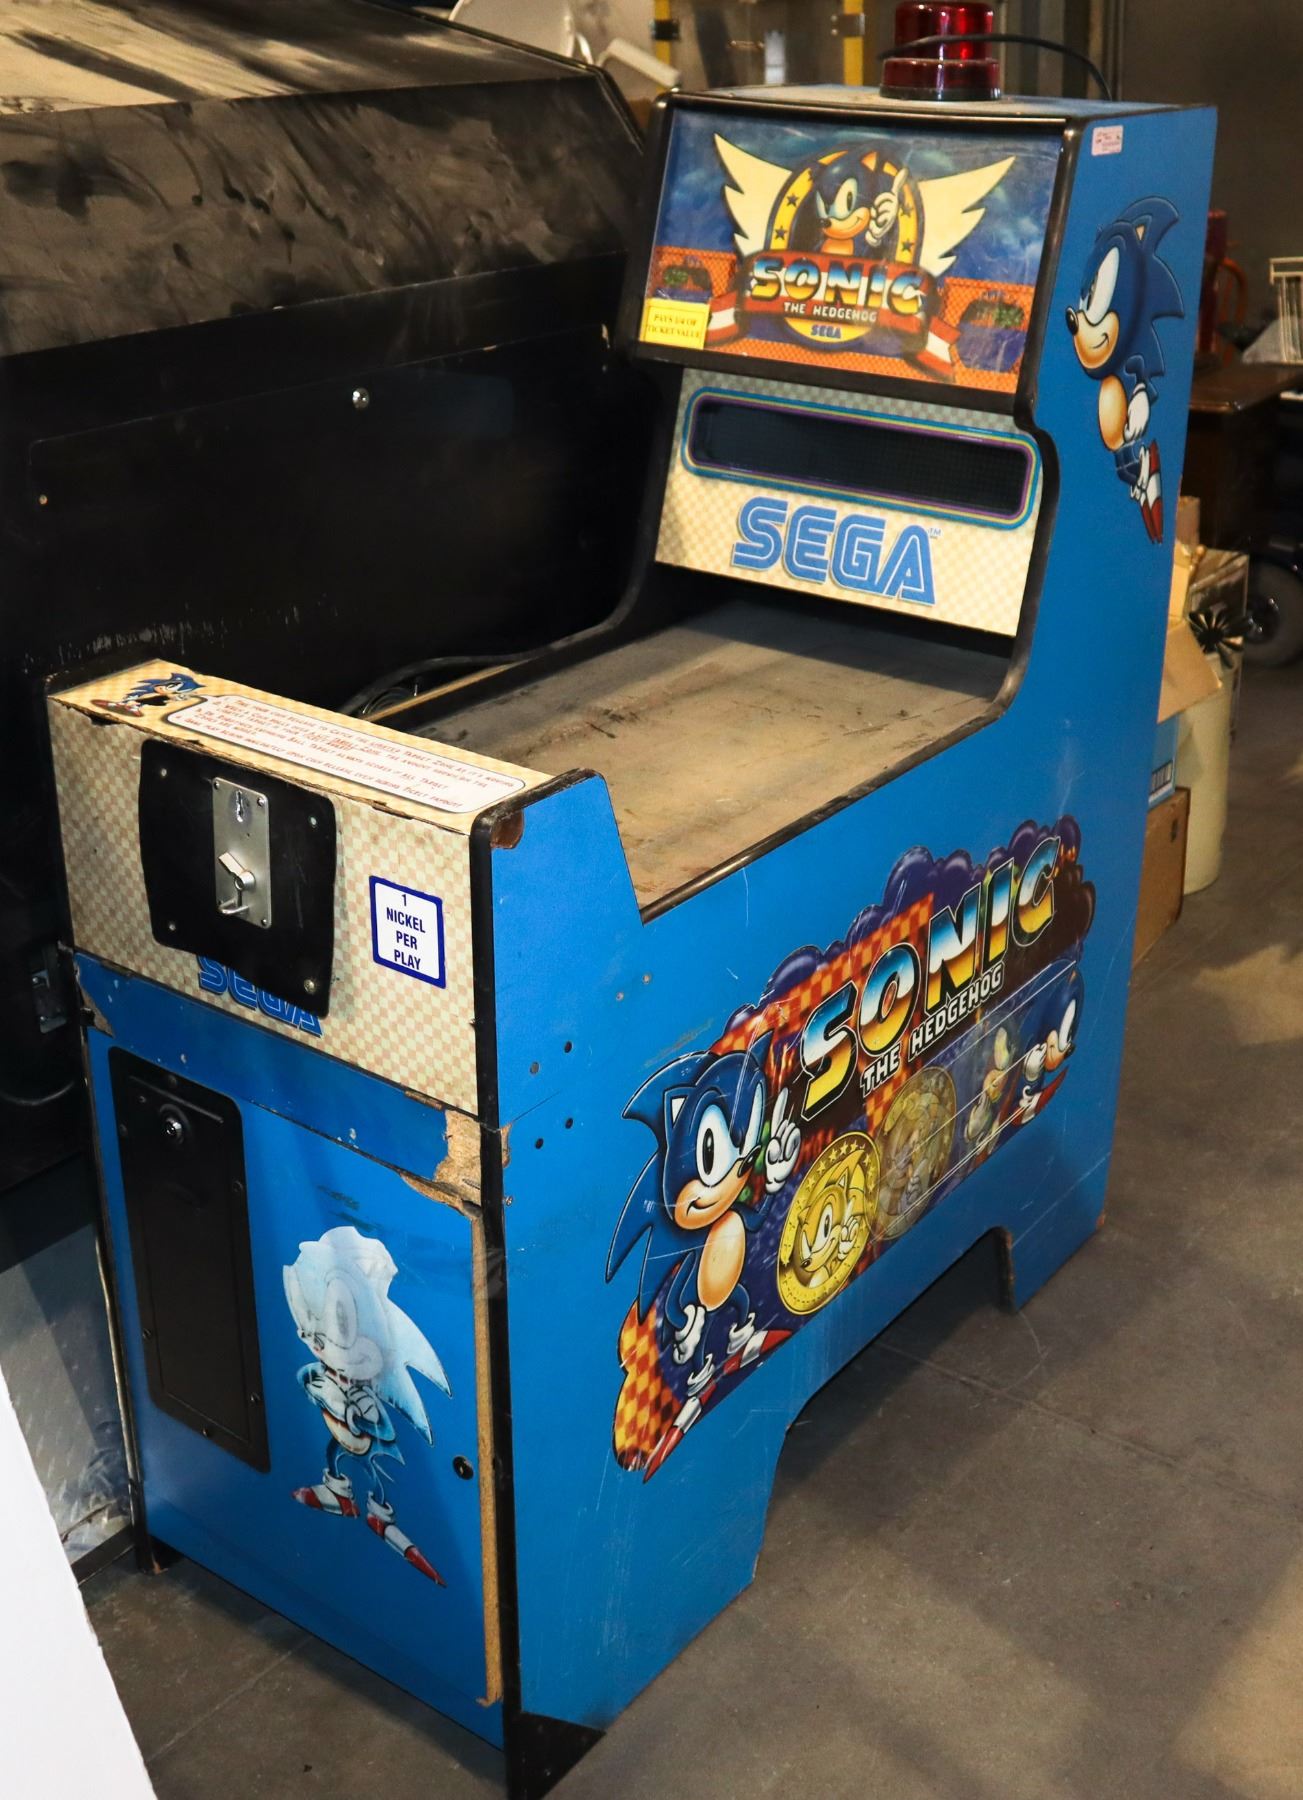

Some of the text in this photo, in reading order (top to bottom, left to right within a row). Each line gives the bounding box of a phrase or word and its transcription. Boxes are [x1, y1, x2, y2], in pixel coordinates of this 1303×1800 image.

[751, 257, 922, 315] SONIC
[653, 313, 673, 323] PAYS
[784, 302, 877, 322] THE HEDGEHOG
[811, 324, 841, 339] SEGA
[731, 496, 936, 606] SEGA
[401, 894, 408, 907] 1
[386, 907, 426, 933] NICKEL
[396, 930, 418, 950] PER
[394, 949, 421, 970] PLAY
[801, 836, 1061, 1121] SONIC
[862, 962, 1005, 1098] THE HEDGEHOG
